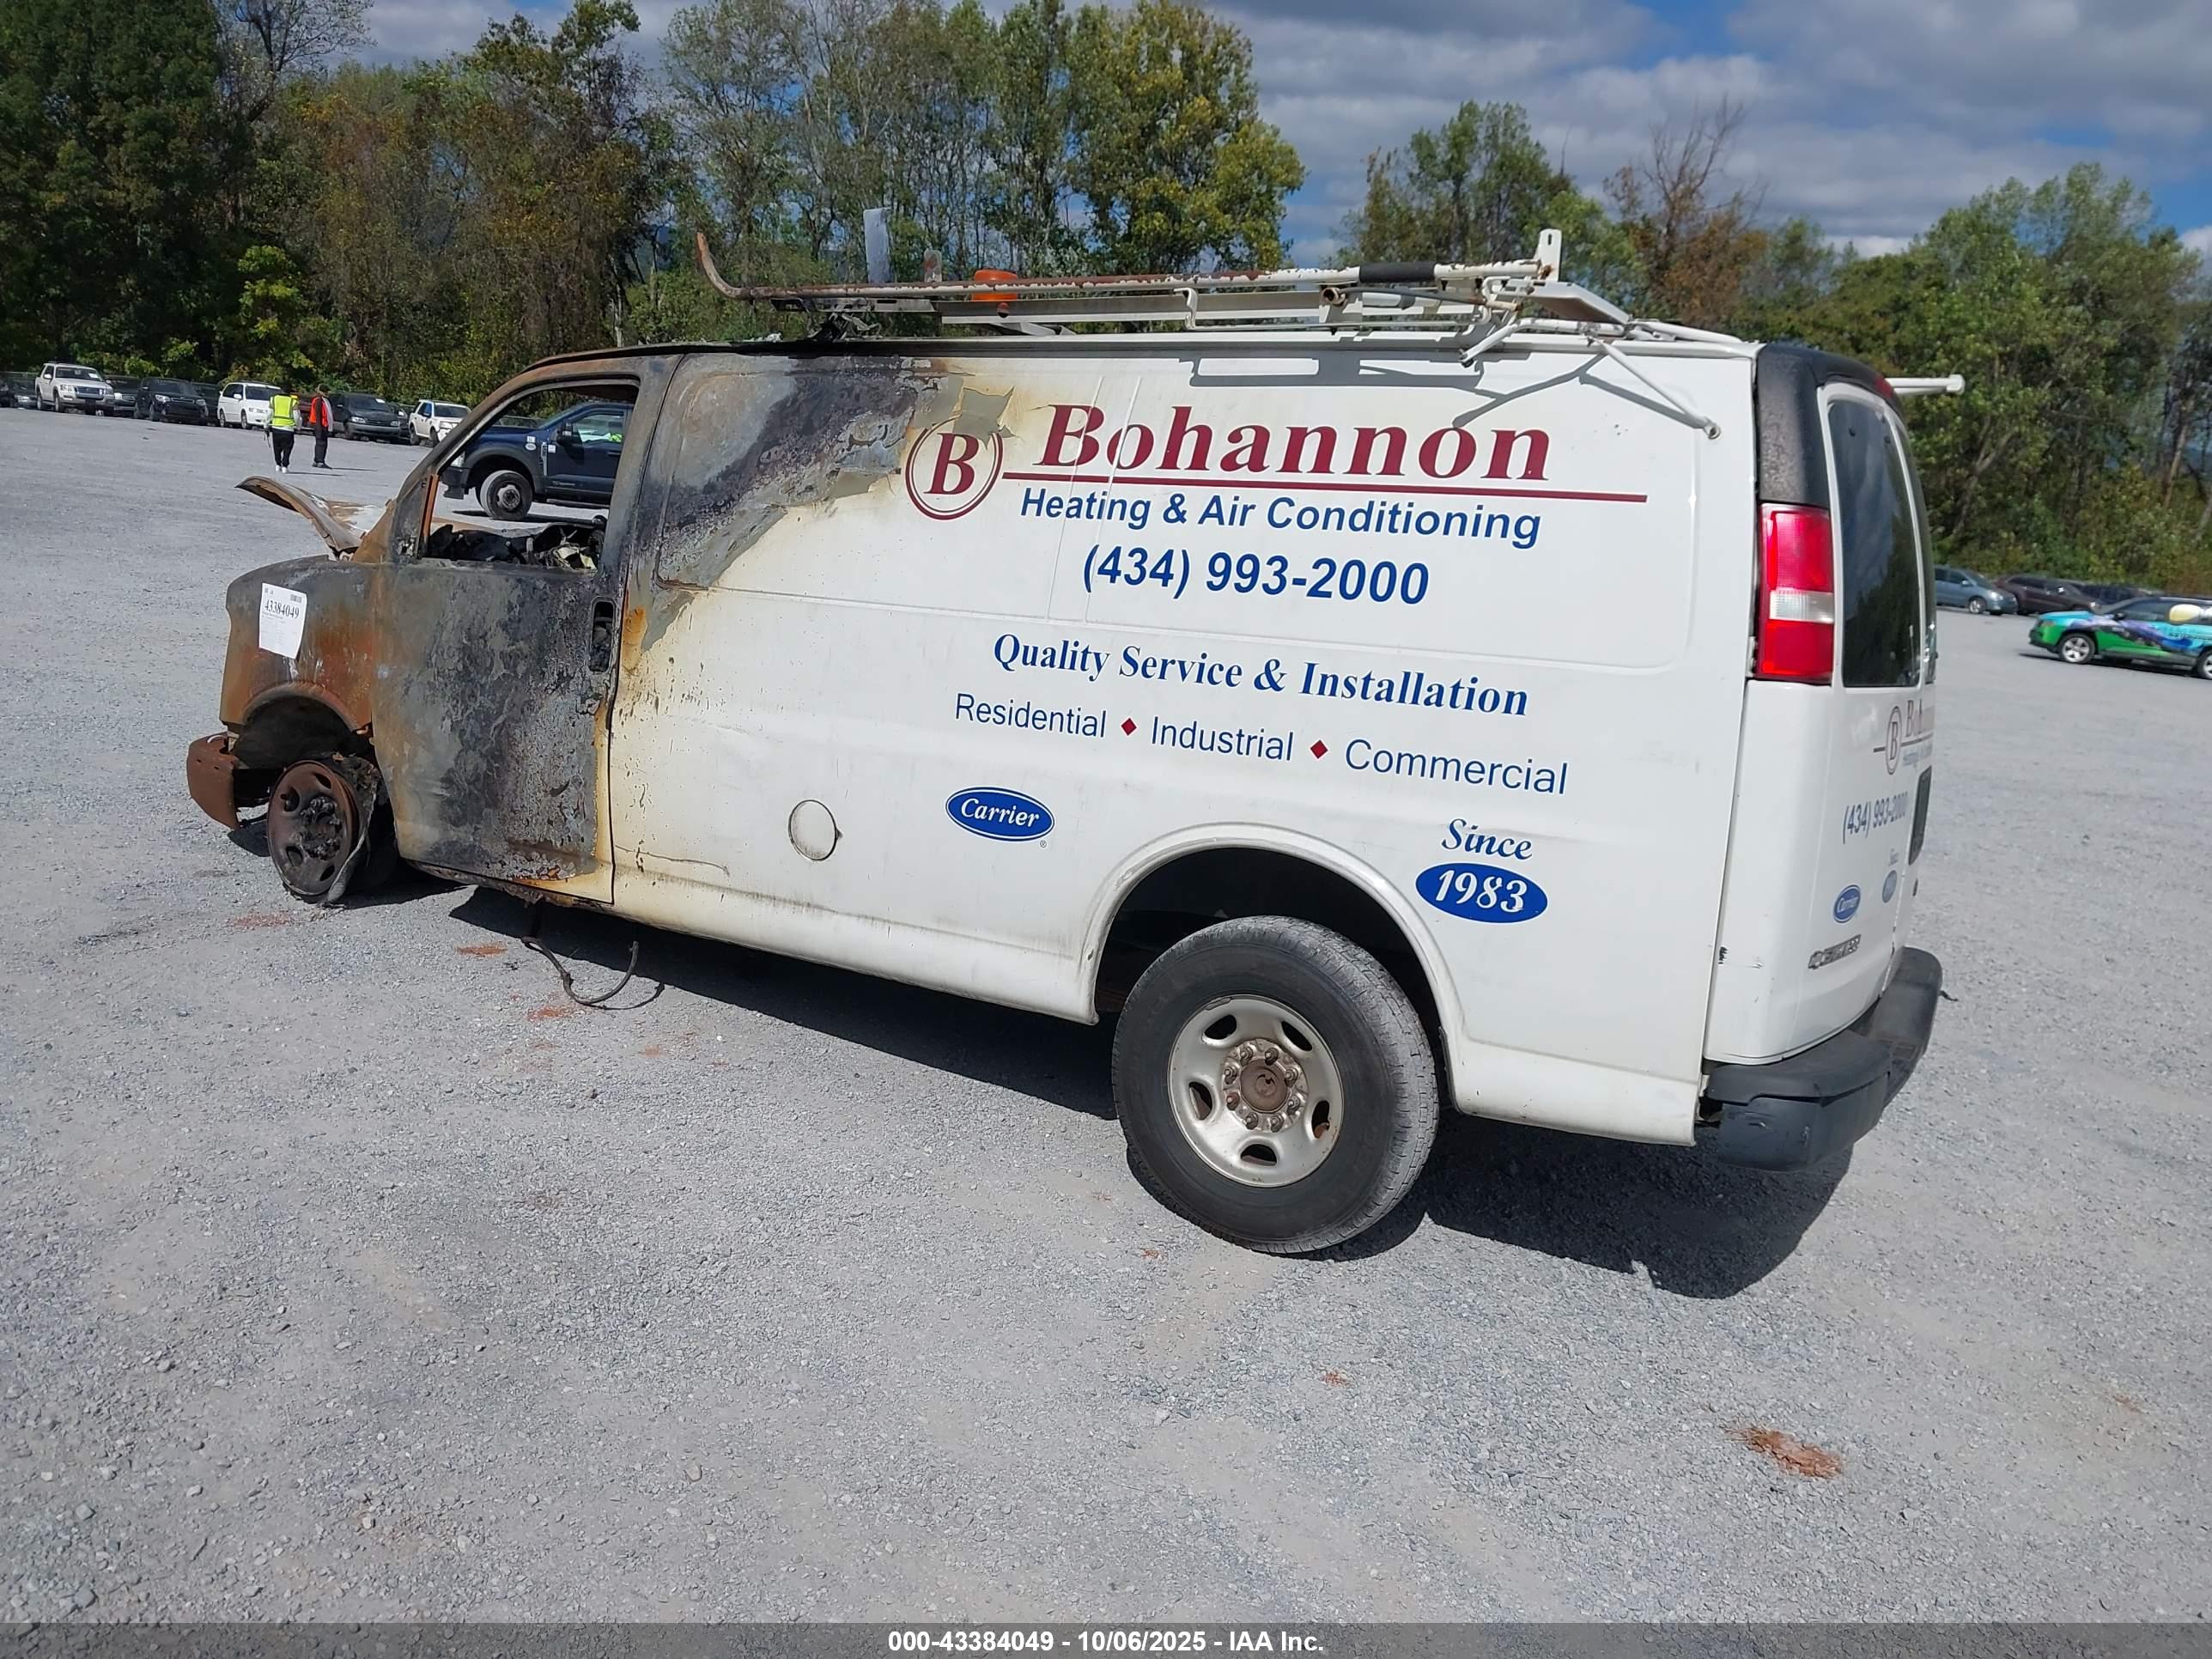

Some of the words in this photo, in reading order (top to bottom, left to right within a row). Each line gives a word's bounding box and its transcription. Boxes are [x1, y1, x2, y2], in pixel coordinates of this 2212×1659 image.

[925, 433, 979, 495] B
[1032, 404, 1549, 480] Bohannon
[1021, 488, 1151, 530] Heating
[1163, 493, 1188, 524] &
[1198, 495, 1255, 526] Air
[1267, 495, 1540, 550] Conditioning
[1084, 545, 1190, 599] (434)
[1206, 552, 1430, 605] 993-2000
[264, 599, 300, 619] 43384049
[994, 634, 1110, 682] Quality
[1120, 646, 1243, 688] Service
[1254, 659, 1287, 692] &
[1298, 661, 1528, 716] Installation
[956, 693, 1107, 738] Residential
[1152, 716, 1293, 761] Industrial
[1346, 738, 1568, 795] Commercial
[961, 798, 1040, 828] Carrier
[1442, 818, 1533, 860] Since
[1843, 800, 1872, 845] (434)
[1435, 868, 1528, 913] 1983
